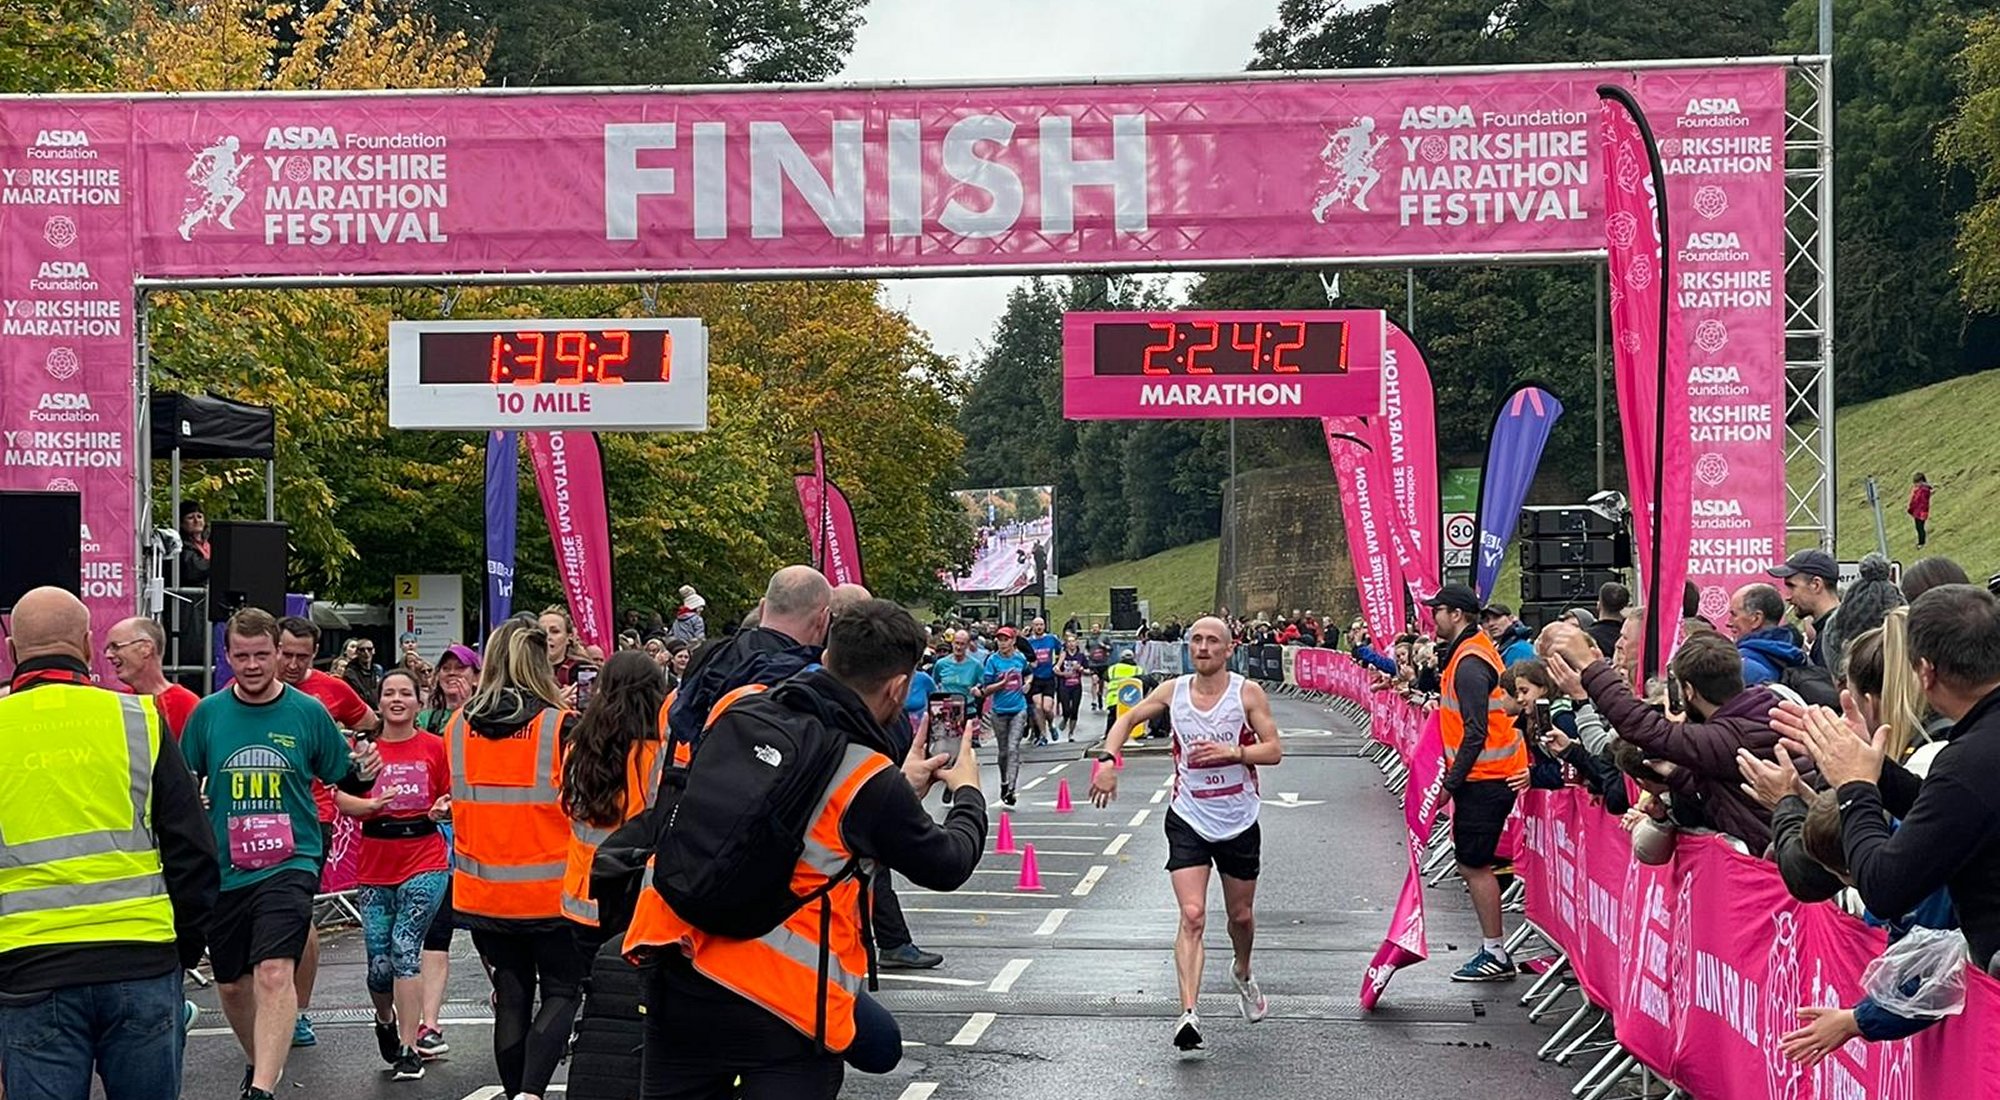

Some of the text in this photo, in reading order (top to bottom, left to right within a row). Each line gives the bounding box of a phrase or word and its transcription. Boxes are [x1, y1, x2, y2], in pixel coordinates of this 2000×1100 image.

[1685, 98, 1741, 115] ASDA
[1400, 105, 1588, 130] ASDA Foundation
[1677, 115, 1750, 128] Foundation
[35, 130, 90, 147] ASDA
[264, 126, 447, 149] ASDA Foundation
[1400, 130, 1588, 163] YORKSHIRE
[26, 147, 98, 160] Foundation
[264, 154, 447, 182] YORKSHIRE
[604, 113, 1148, 241] FINISH
[1400, 161, 1588, 191] MARATHON
[2, 169, 120, 188] YORKSHIRE
[1, 188, 121, 205] MARATHON
[264, 184, 447, 210] MARATHON
[1400, 189, 1588, 226] FESTIVAL
[264, 213, 448, 245] FESTIVAL
[1686, 232, 1741, 249] ASDA
[1677, 251, 1750, 263] Foundation
[38, 262, 90, 279] ASDA
[30, 279, 99, 291] Foundation
[1677, 270, 1772, 290] RKSHIRE
[3, 301, 121, 319] YORKSHIRE
[3, 319, 121, 336] MARATHON
[1142, 320, 1350, 375] 2:24:21
[489, 330, 673, 387] 1:39:21
[1687, 366, 1741, 384] ASDA
[1139, 384, 1301, 406] MARATHON
[1687, 384, 1750, 396] oundation
[38, 393, 91, 410] ASDA
[497, 393, 591, 413] 10 MILE
[29, 410, 100, 423] Foundation
[1689, 404, 1772, 424] RKSHIRE
[3, 431, 121, 450] YORKSHIRE
[1690, 424, 1772, 442] RATHON
[4, 451, 122, 468] MARATHON
[1691, 499, 1743, 517] ASDA
[1451, 525, 1473, 538] 30
[1688, 538, 1773, 556] RKSHIRE
[1687, 557, 1774, 575] RATHON
[403, 582, 412, 595] 2
[1204, 775, 1225, 785] 301
[241, 837, 284, 854] 11555
[1695, 950, 1723, 1017] RUN
[1742, 977, 1759, 1048] ALL
